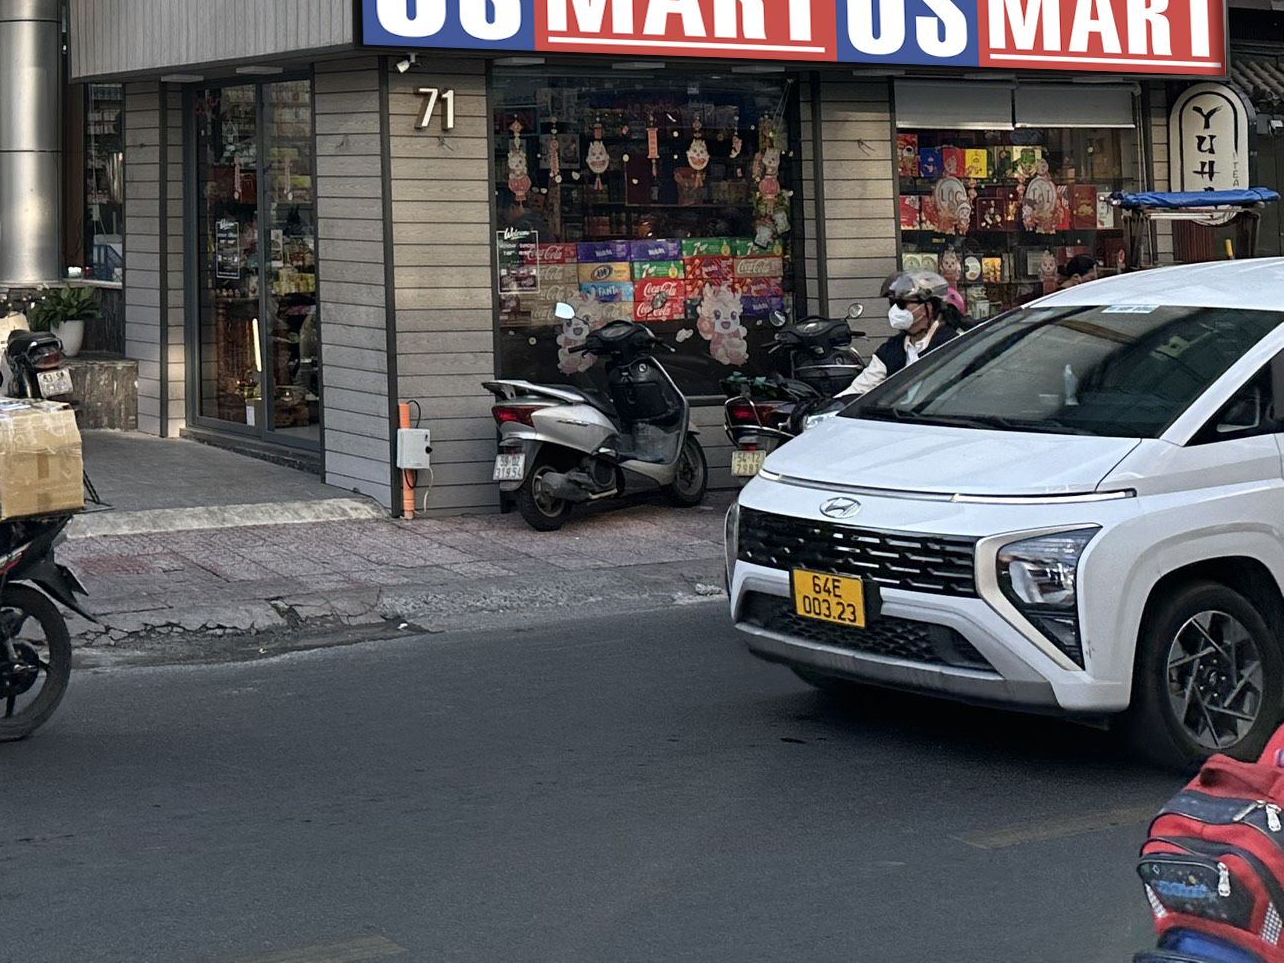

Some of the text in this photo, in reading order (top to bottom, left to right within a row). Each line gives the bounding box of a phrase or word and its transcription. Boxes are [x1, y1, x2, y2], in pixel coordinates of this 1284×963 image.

[417, 87, 455, 129] 71
[812, 575, 841, 599] 64E
[803, 594, 857, 623] 003.23
